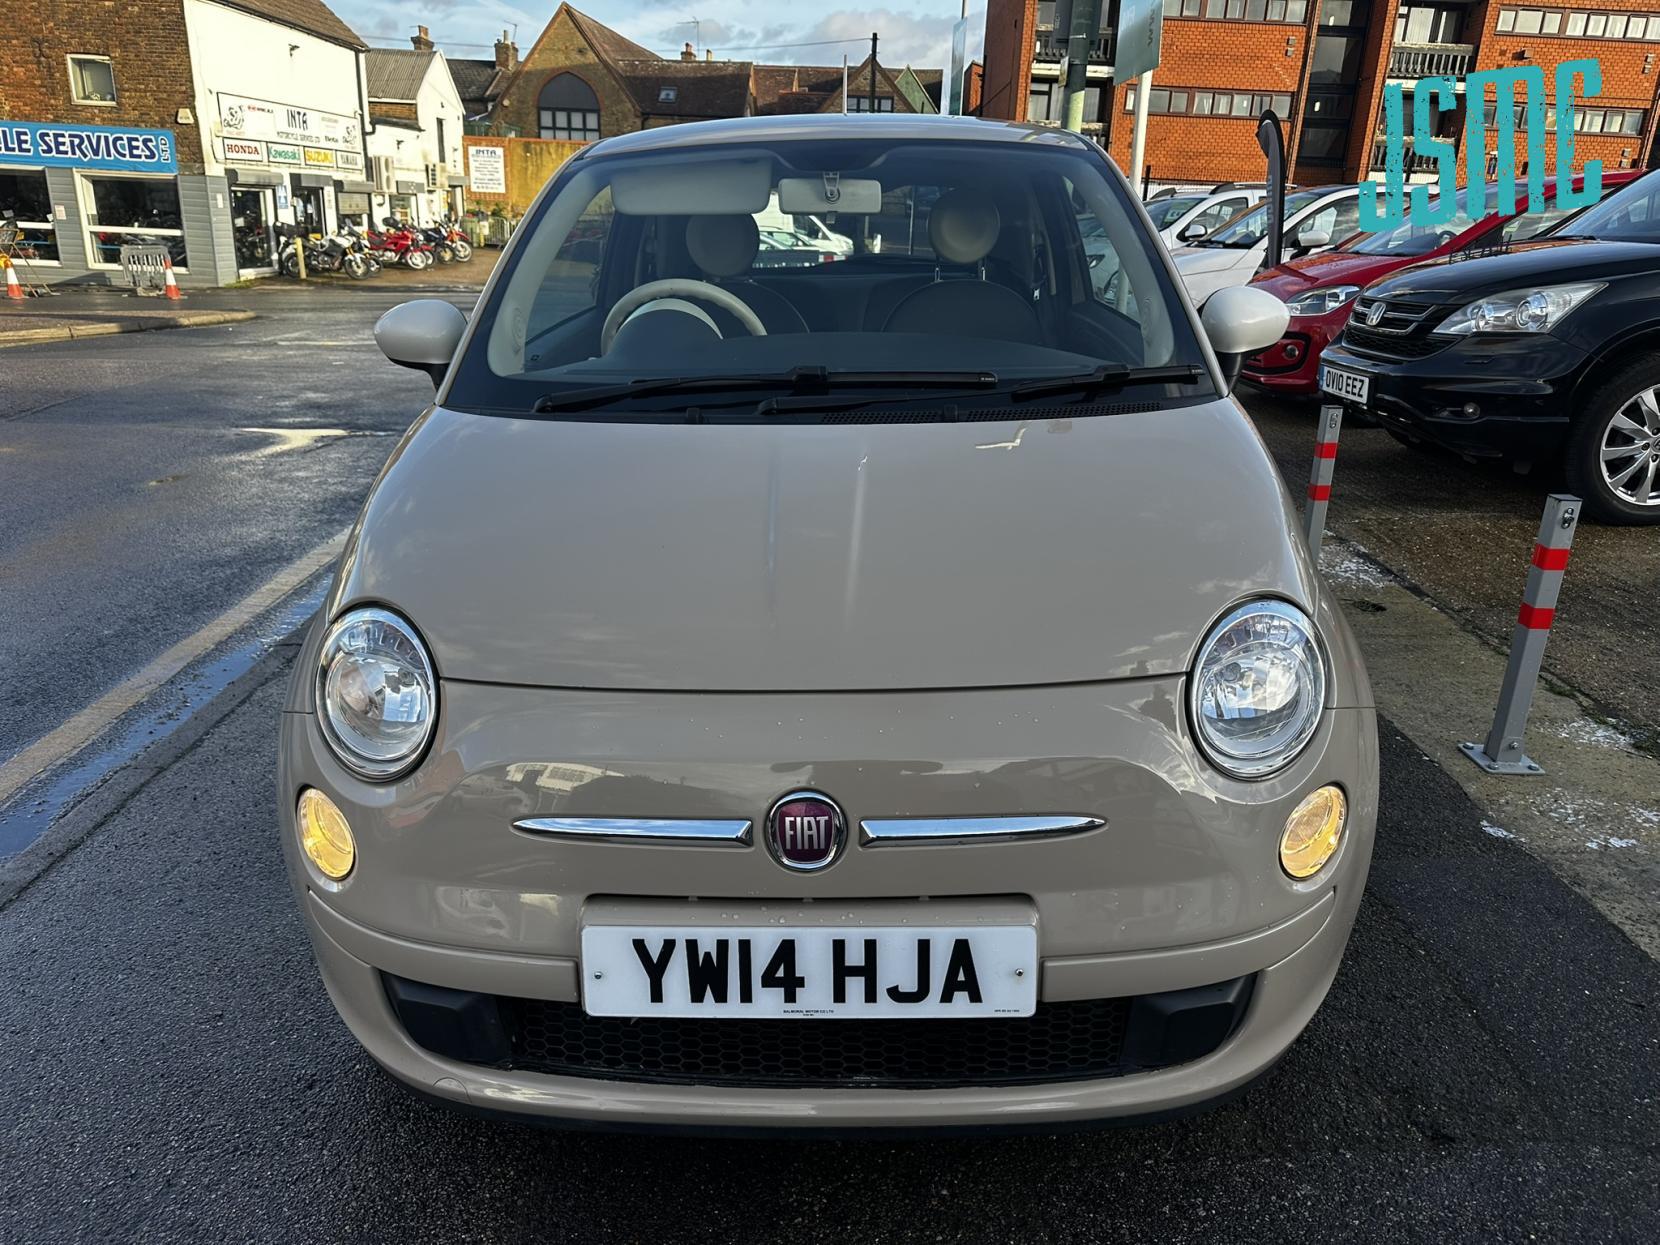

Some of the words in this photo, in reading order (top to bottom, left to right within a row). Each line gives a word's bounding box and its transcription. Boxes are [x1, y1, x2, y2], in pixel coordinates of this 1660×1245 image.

[286, 108, 308, 131] INTA
[0, 127, 33, 155] LE
[37, 131, 158, 162] SERVICES
[160, 137, 171, 163] LTD
[226, 144, 260, 155] HONDA
[269, 145, 300, 161] Kawasaki
[305, 149, 334, 163] SUZUKI
[1326, 370, 1344, 391] OV10
[1345, 375, 1364, 398] EEZ
[784, 816, 828, 850] FIAT
[632, 939, 805, 1003] YW14
[832, 939, 983, 1003] HJA
